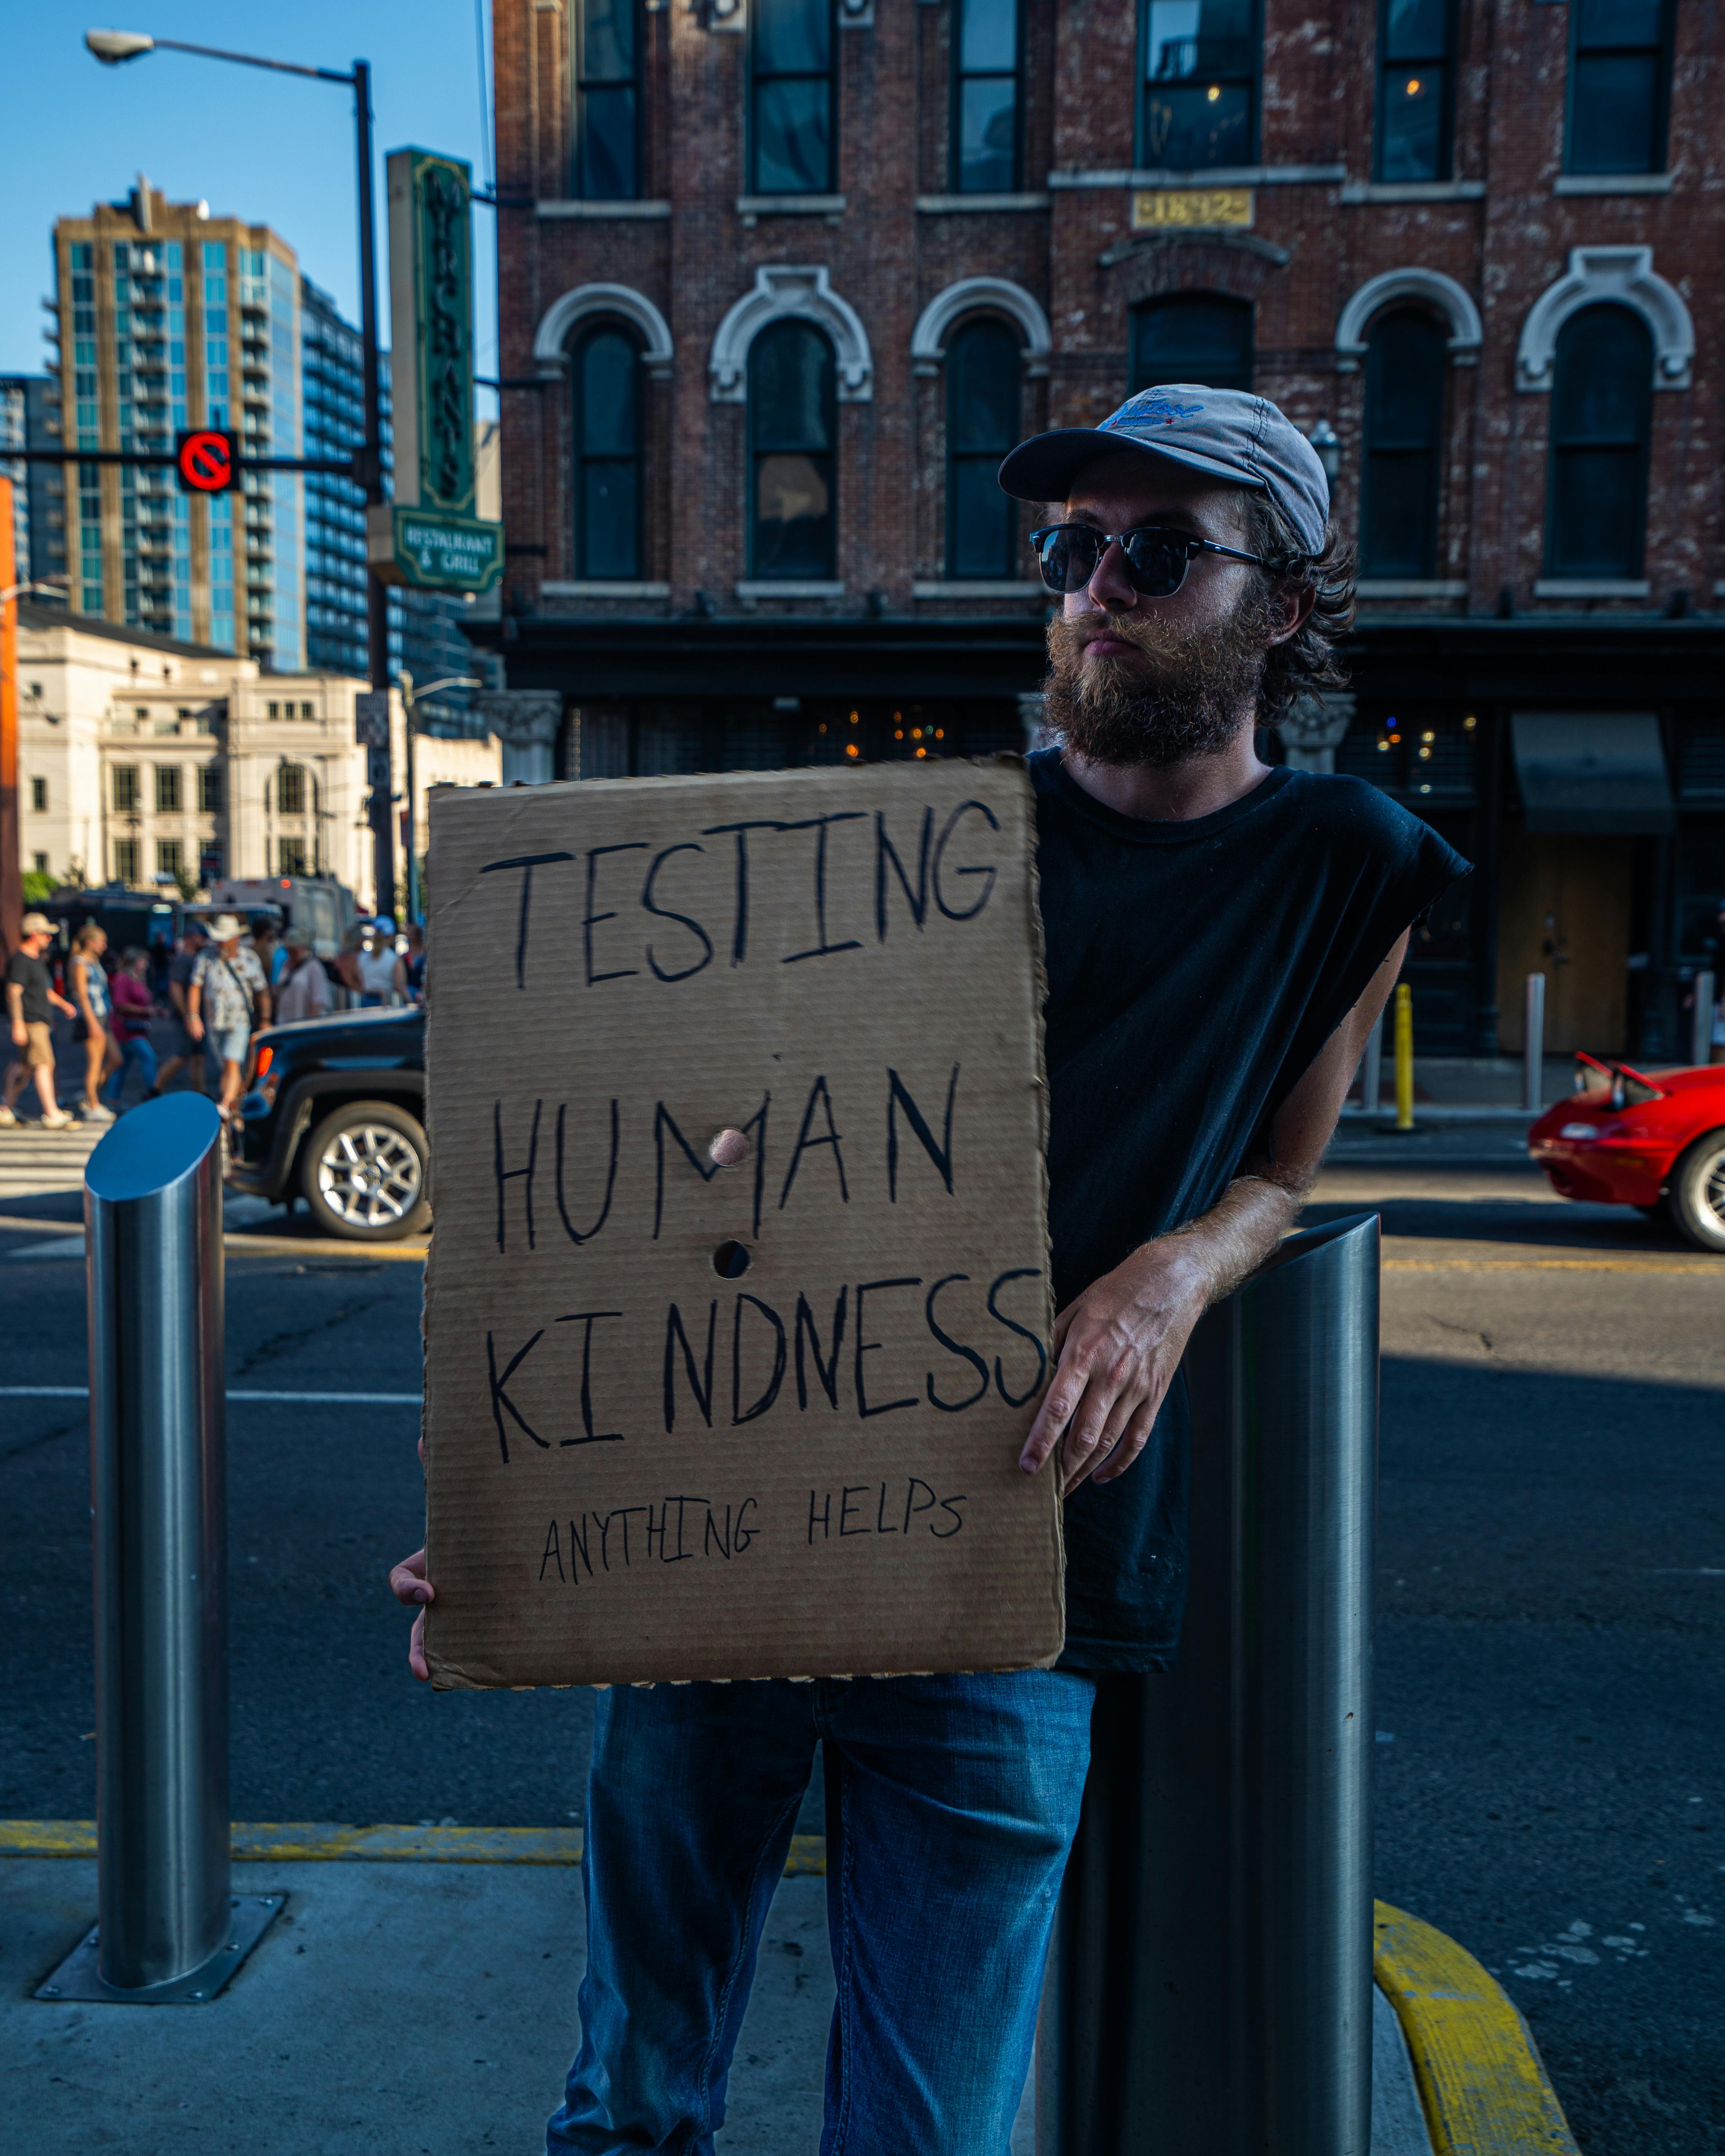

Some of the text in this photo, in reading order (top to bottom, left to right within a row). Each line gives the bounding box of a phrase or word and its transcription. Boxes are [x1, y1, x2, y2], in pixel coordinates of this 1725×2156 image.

[407, 525, 492, 555] RESTAURANT
[440, 552, 480, 575] GRILL
[479, 799, 1000, 990] TESTING
[493, 1061, 961, 1254] HUMAN
[487, 1268, 1047, 1464] KINDNESS
[539, 1477, 967, 1585] ANYTHING HELPS
